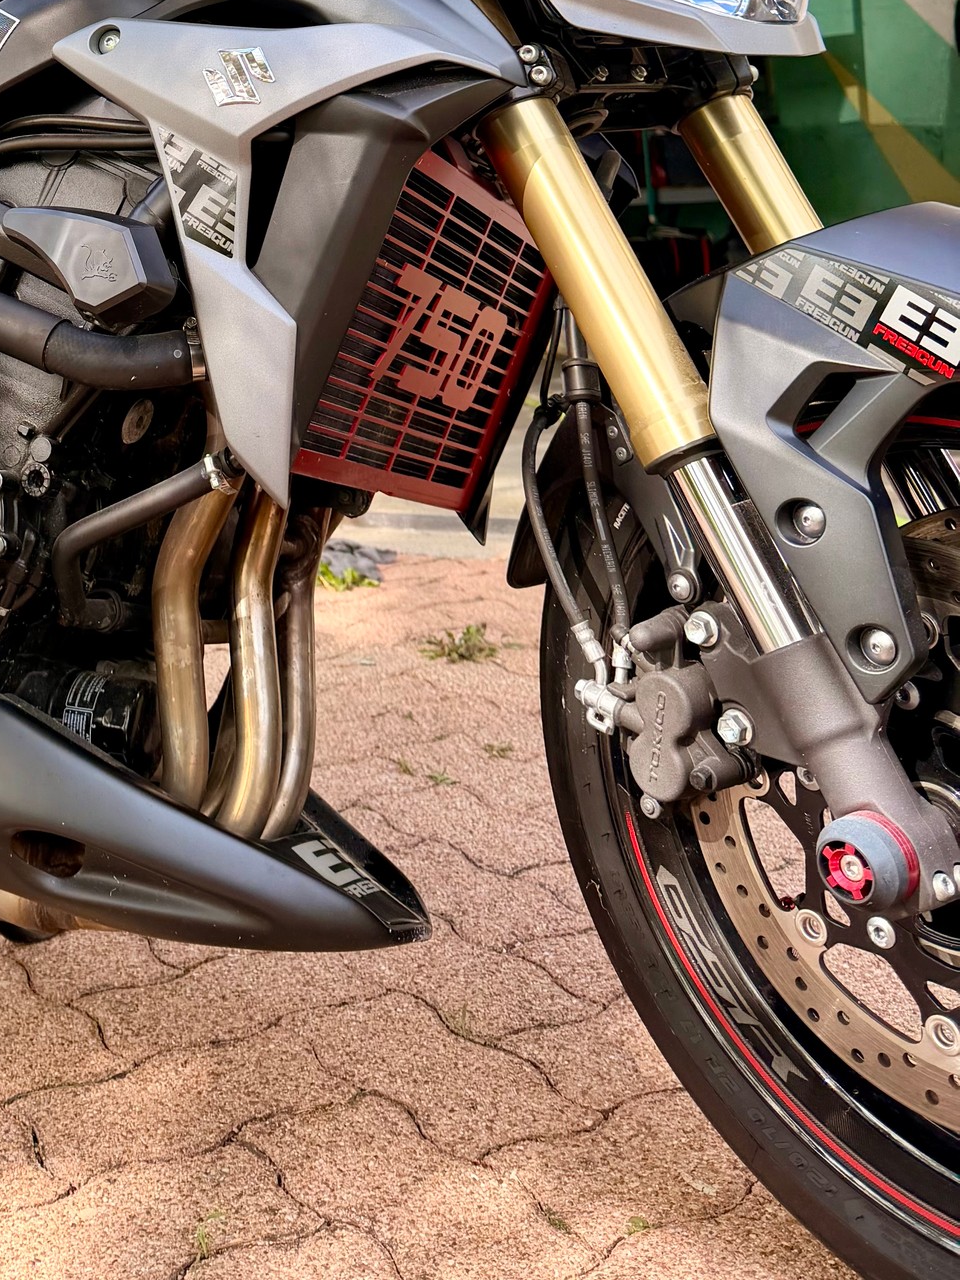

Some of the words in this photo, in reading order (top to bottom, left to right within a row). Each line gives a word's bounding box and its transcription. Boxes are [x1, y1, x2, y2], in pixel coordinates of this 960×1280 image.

[371, 262, 509, 413] 750
[795, 296, 862, 344] FREEGUN
[872, 321, 956, 380] FREEGUN
[648, 690, 667, 783] TOKICO
[656, 864, 809, 1083] GSR
